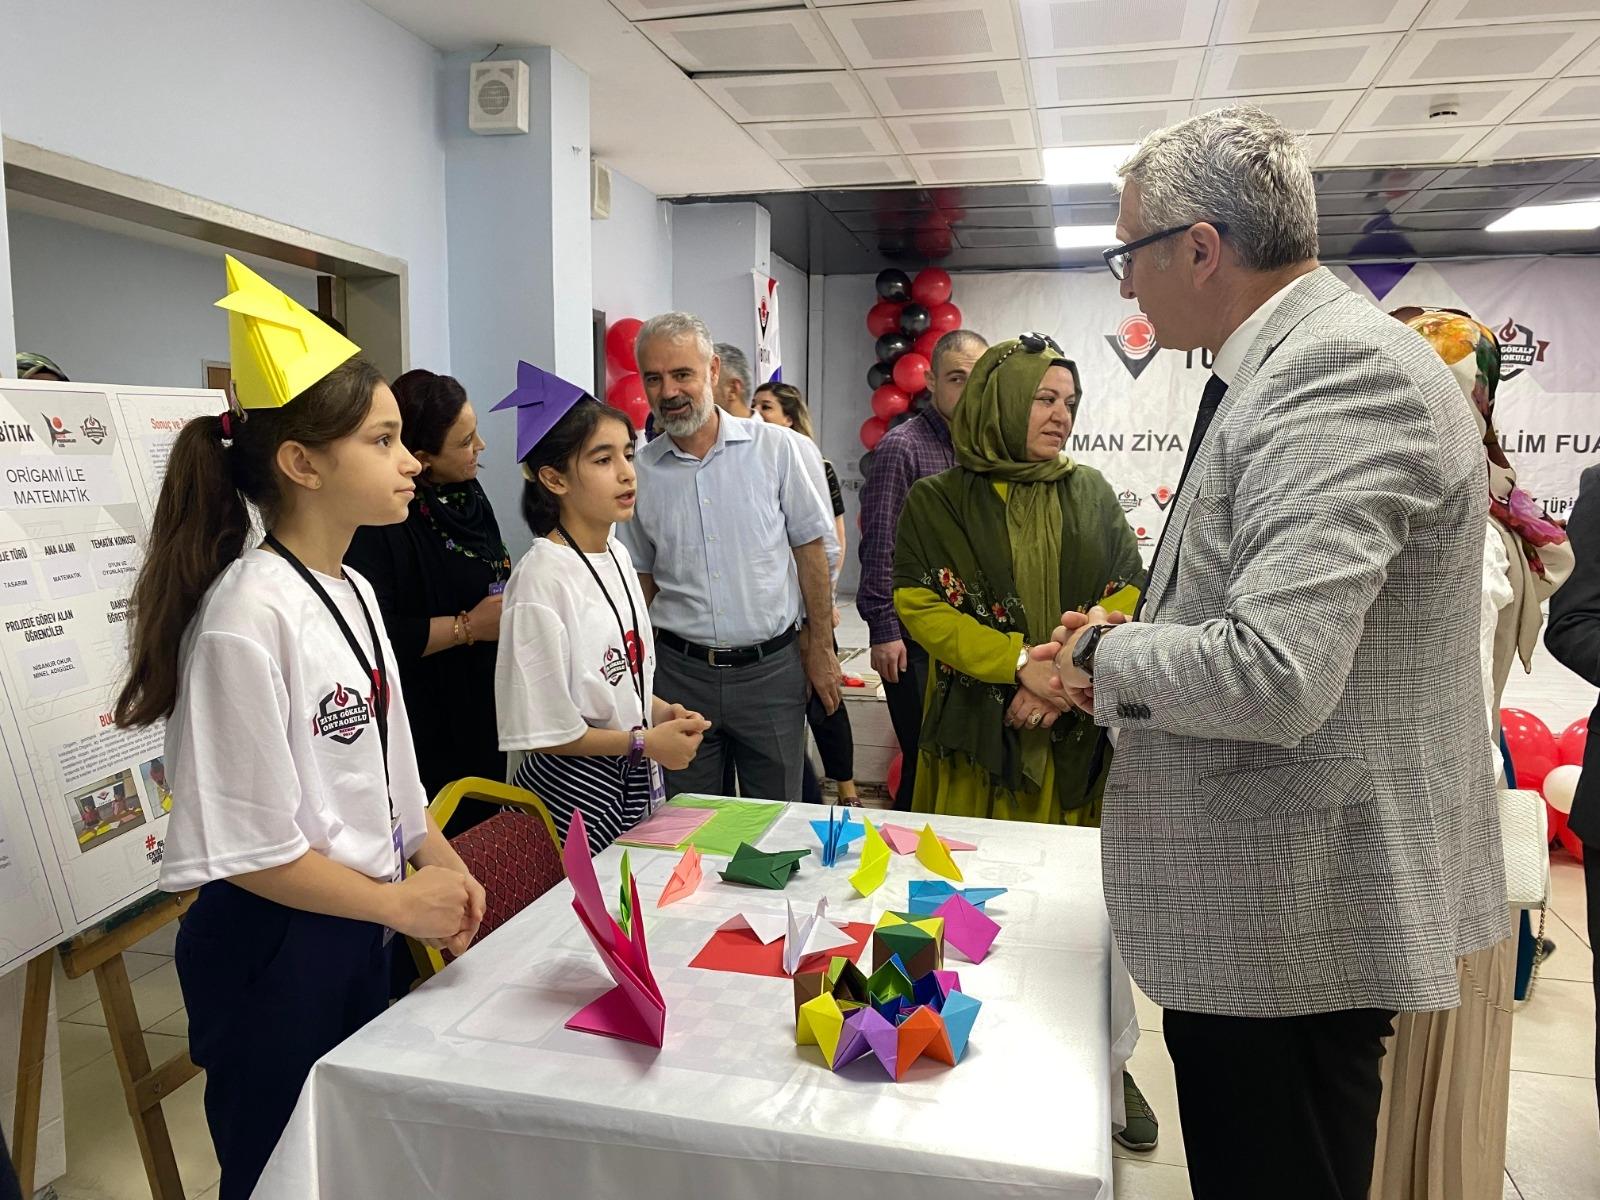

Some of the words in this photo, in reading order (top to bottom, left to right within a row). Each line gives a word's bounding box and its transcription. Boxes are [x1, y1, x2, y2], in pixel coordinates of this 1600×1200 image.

[1500, 344, 1534, 354] GÖKALP
[1061, 434, 1124, 451] MAN
[1131, 429, 1184, 451] ZİYA
[6, 466, 64, 483] ORİGAMİ
[65, 466, 86, 482] İLE
[14, 487, 90, 504] MATEMATİK
[45, 545, 57, 556] ANA
[58, 542, 76, 553] ALANI
[91, 536, 114, 549] TEMATİK
[114, 535, 136, 546] KONUSU
[3, 580, 28, 588] TASARIM
[5, 617, 36, 632] PROJEDE
[35, 613, 56, 626] GÖREV
[57, 609, 74, 621] ALAN
[24, 625, 65, 642] ÖĞRENCİLER
[320, 713, 338, 726] ZİYA
[340, 706, 367, 718] GÖKALP
[322, 714, 367, 731] ORTAOKULU
